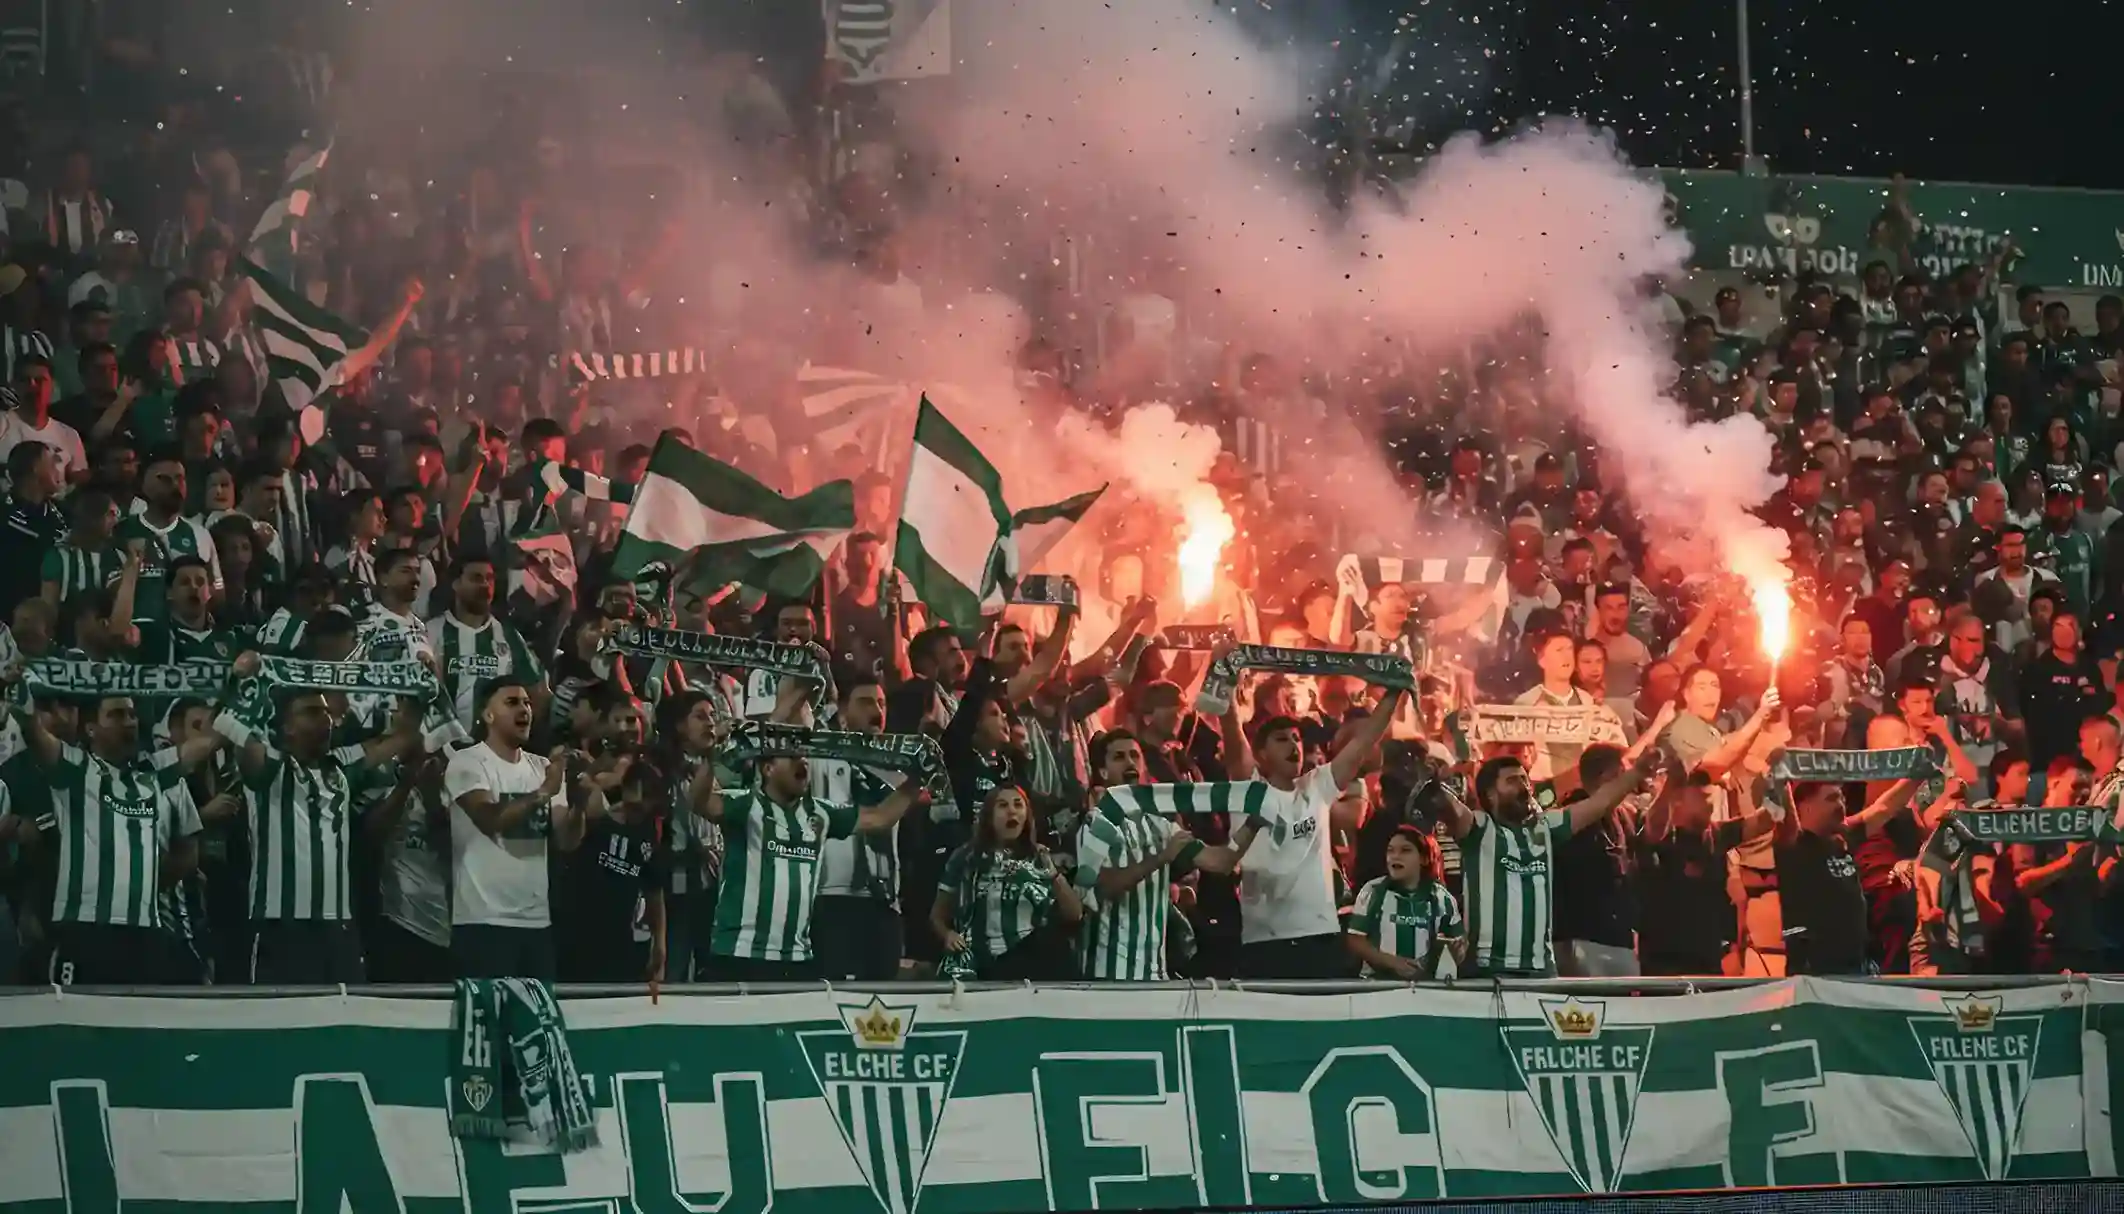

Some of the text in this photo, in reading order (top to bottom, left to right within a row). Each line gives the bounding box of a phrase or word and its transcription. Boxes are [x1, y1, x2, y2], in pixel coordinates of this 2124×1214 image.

[2003, 1034, 2029, 1057] CF
[824, 1052, 947, 1079] ELCHE CF
[1611, 1046, 1640, 1069] CF
